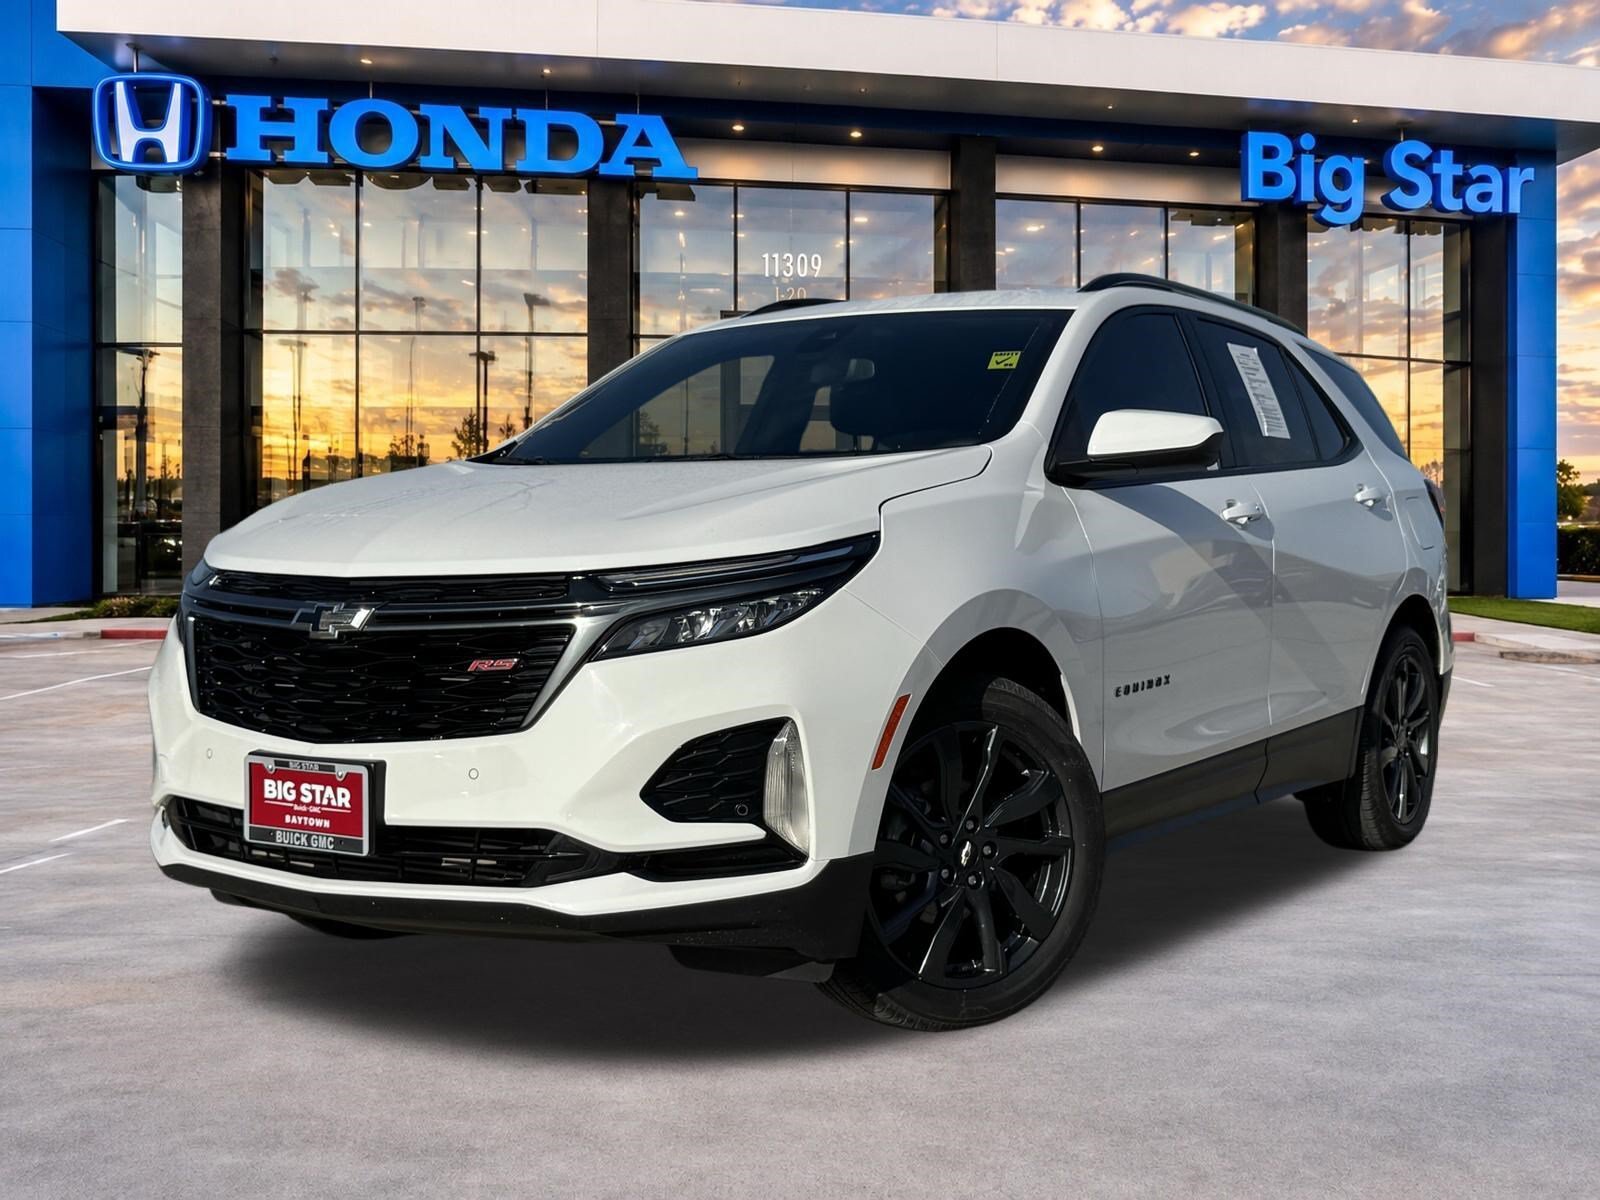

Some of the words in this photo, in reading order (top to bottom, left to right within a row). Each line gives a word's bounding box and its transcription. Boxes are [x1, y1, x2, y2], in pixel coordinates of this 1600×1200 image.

[226, 94, 700, 180] HONDA
[1241, 131, 1366, 226] Big
[1381, 140, 1536, 215] Star
[761, 252, 822, 278] 11309
[467, 658, 518, 672] RS
[1115, 674, 1171, 698] EQUINOX
[288, 761, 301, 769] BIG
[301, 762, 319, 771] STAR
[263, 778, 296, 801] BIG
[300, 783, 351, 808] STAR
[285, 814, 330, 828] BAYTOWN
[275, 830, 309, 846] BUICK
[310, 834, 334, 849] GMC
